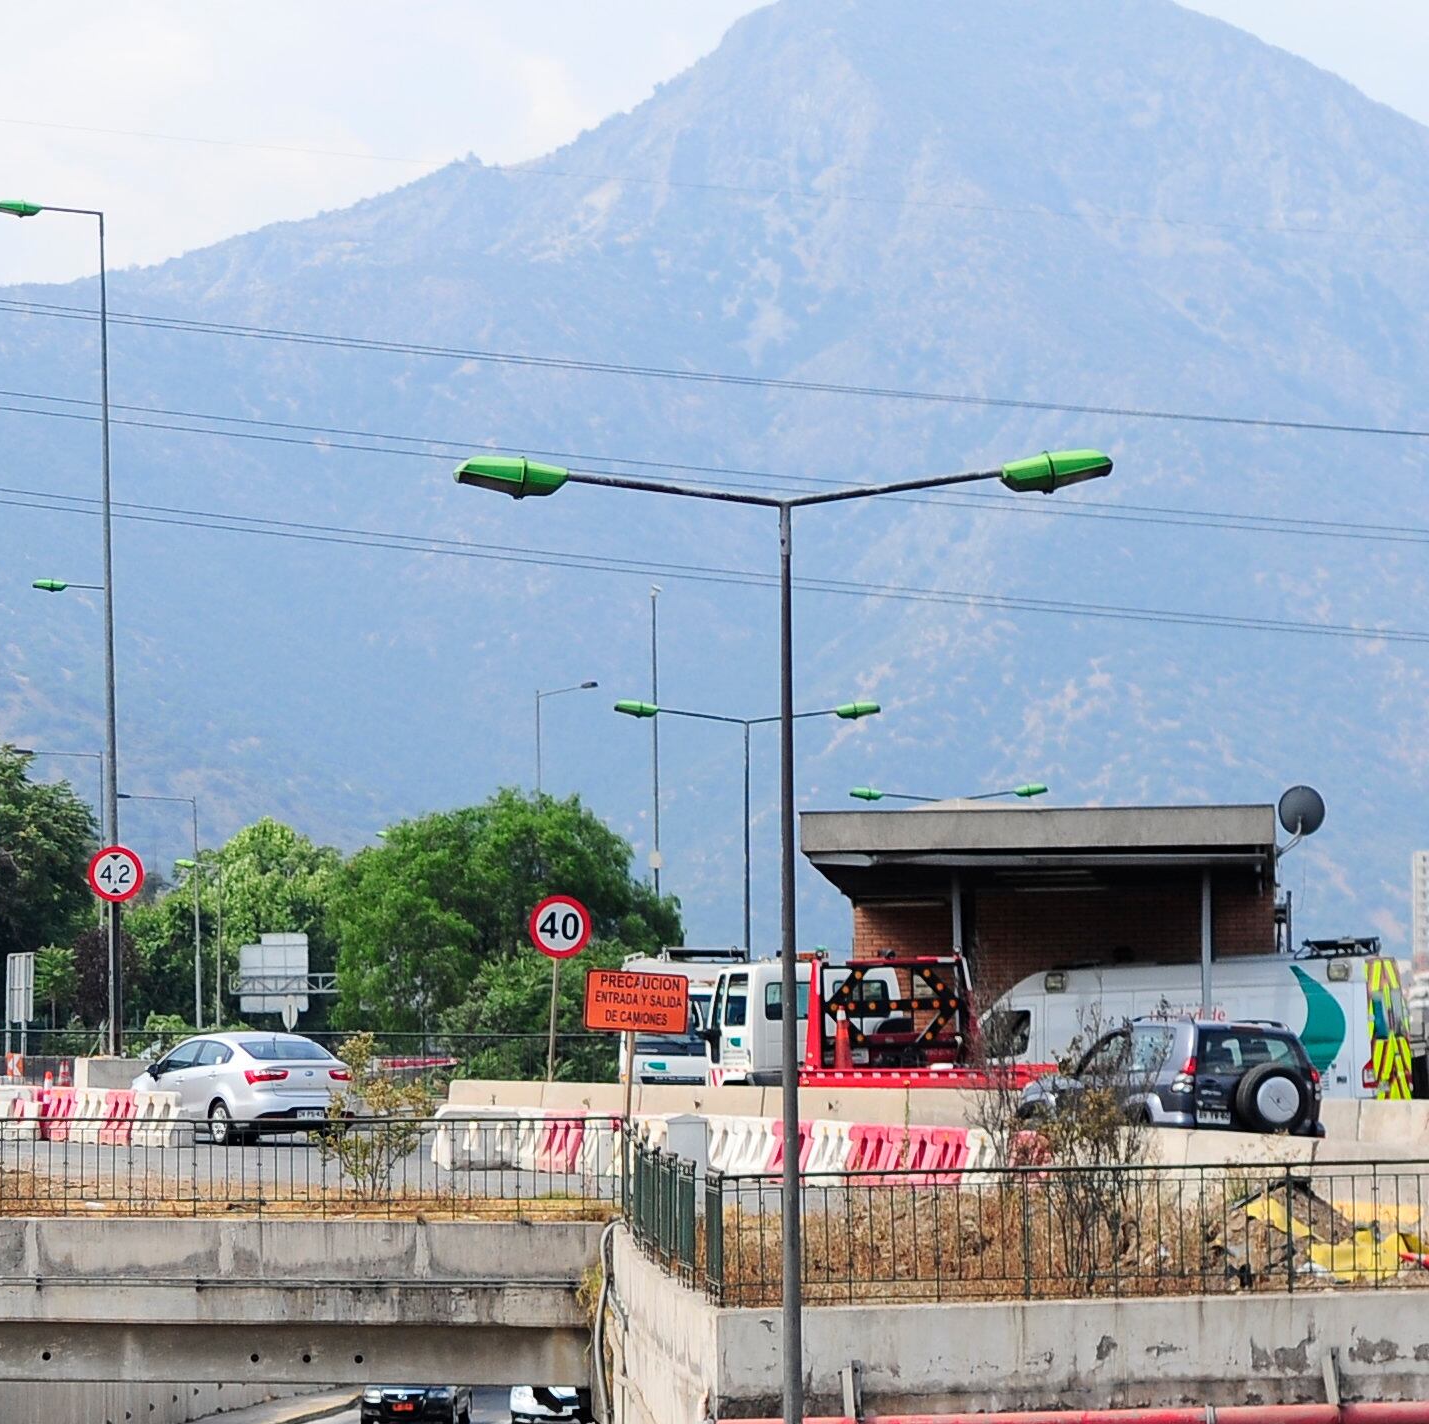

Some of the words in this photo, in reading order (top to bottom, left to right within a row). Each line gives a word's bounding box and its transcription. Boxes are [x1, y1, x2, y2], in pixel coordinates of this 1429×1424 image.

[539, 911, 579, 940] 40
[601, 974, 680, 991] PRECAUCION
[595, 990, 638, 1005] ENTRADA
[642, 994, 648, 1005] Y
[650, 994, 682, 1008] SALIDA
[605, 1009, 617, 1022] DE
[619, 1010, 667, 1026] CAMIONES
